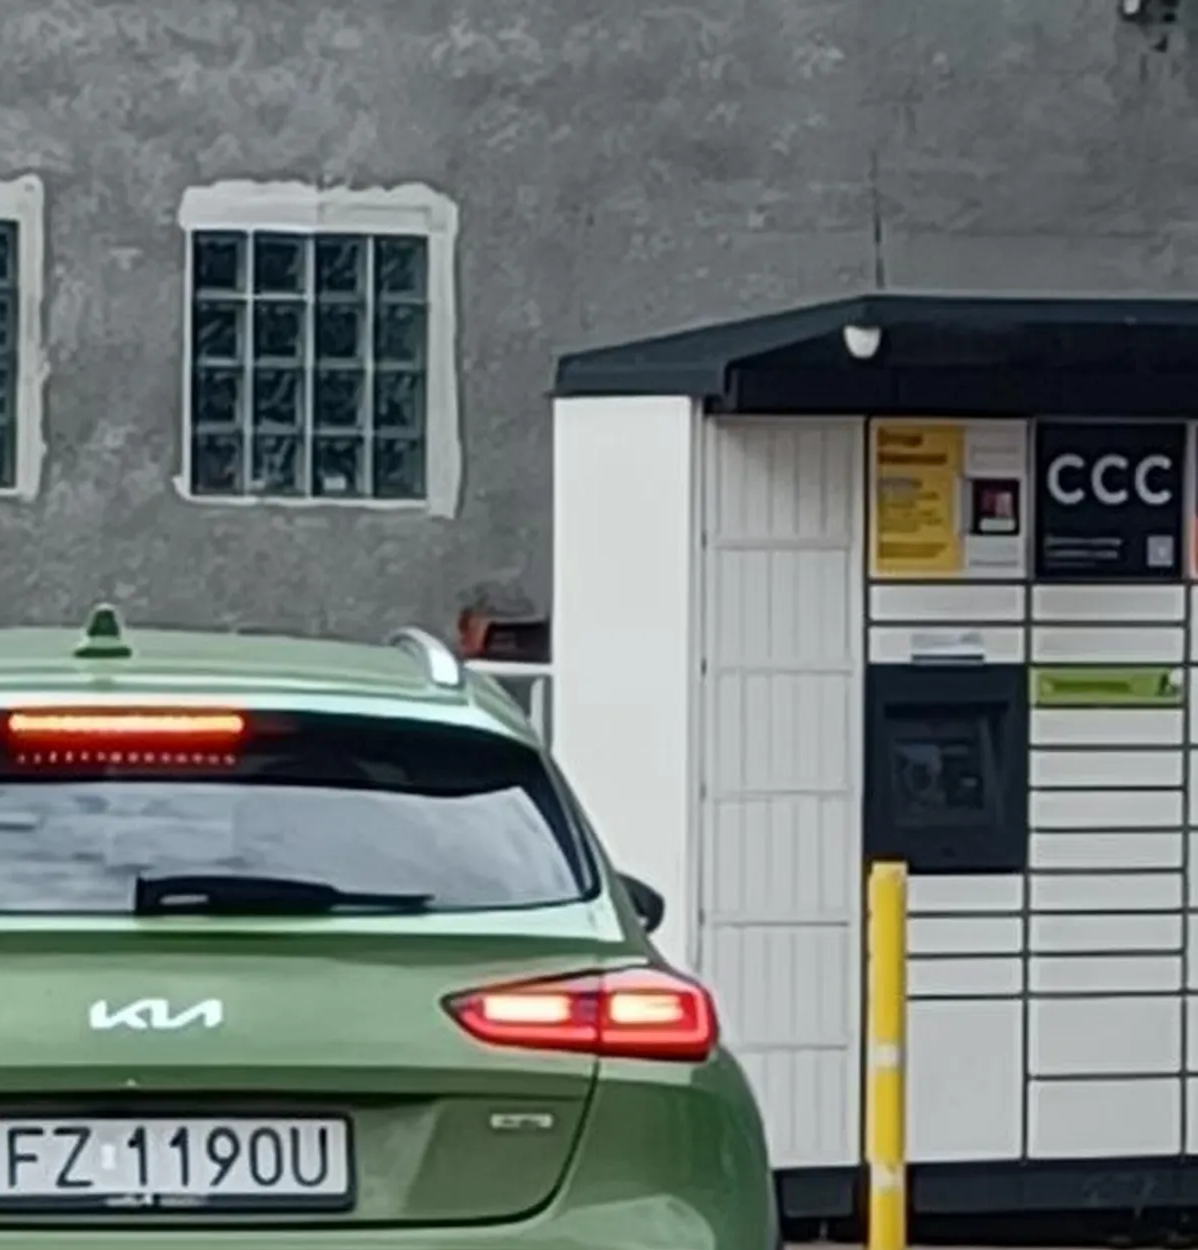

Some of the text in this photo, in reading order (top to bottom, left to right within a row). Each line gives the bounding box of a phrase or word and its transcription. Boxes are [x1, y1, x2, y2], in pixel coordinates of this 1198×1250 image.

[1047, 454, 1172, 504] CCC
[7, 1126, 94, 1188] FZ
[126, 1125, 330, 1188] 1190U
